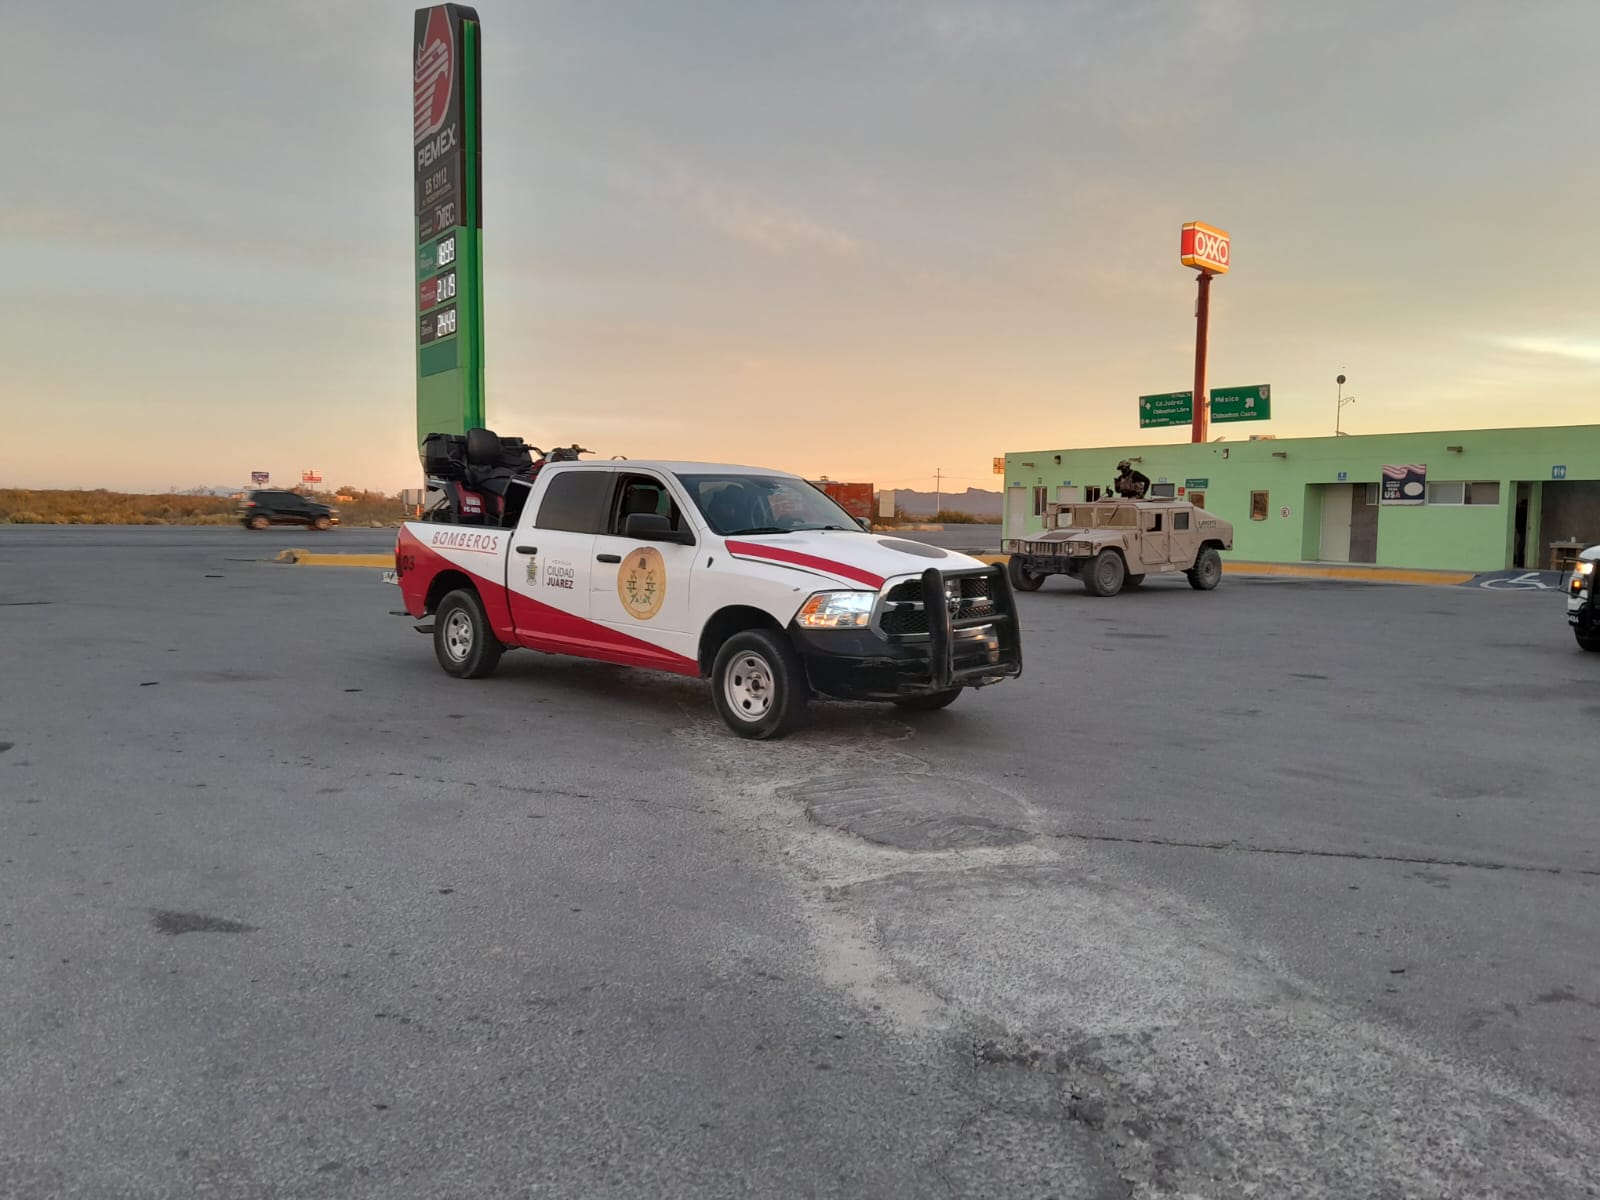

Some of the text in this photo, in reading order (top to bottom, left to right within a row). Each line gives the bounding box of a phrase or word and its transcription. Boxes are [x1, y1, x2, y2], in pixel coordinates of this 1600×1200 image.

[418, 122, 456, 172] PEMEX
[1195, 230, 1229, 264] OXXO
[1384, 491, 1401, 499] USA
[432, 531, 499, 551] BOMBEROS
[547, 565, 575, 578] CIUDAD
